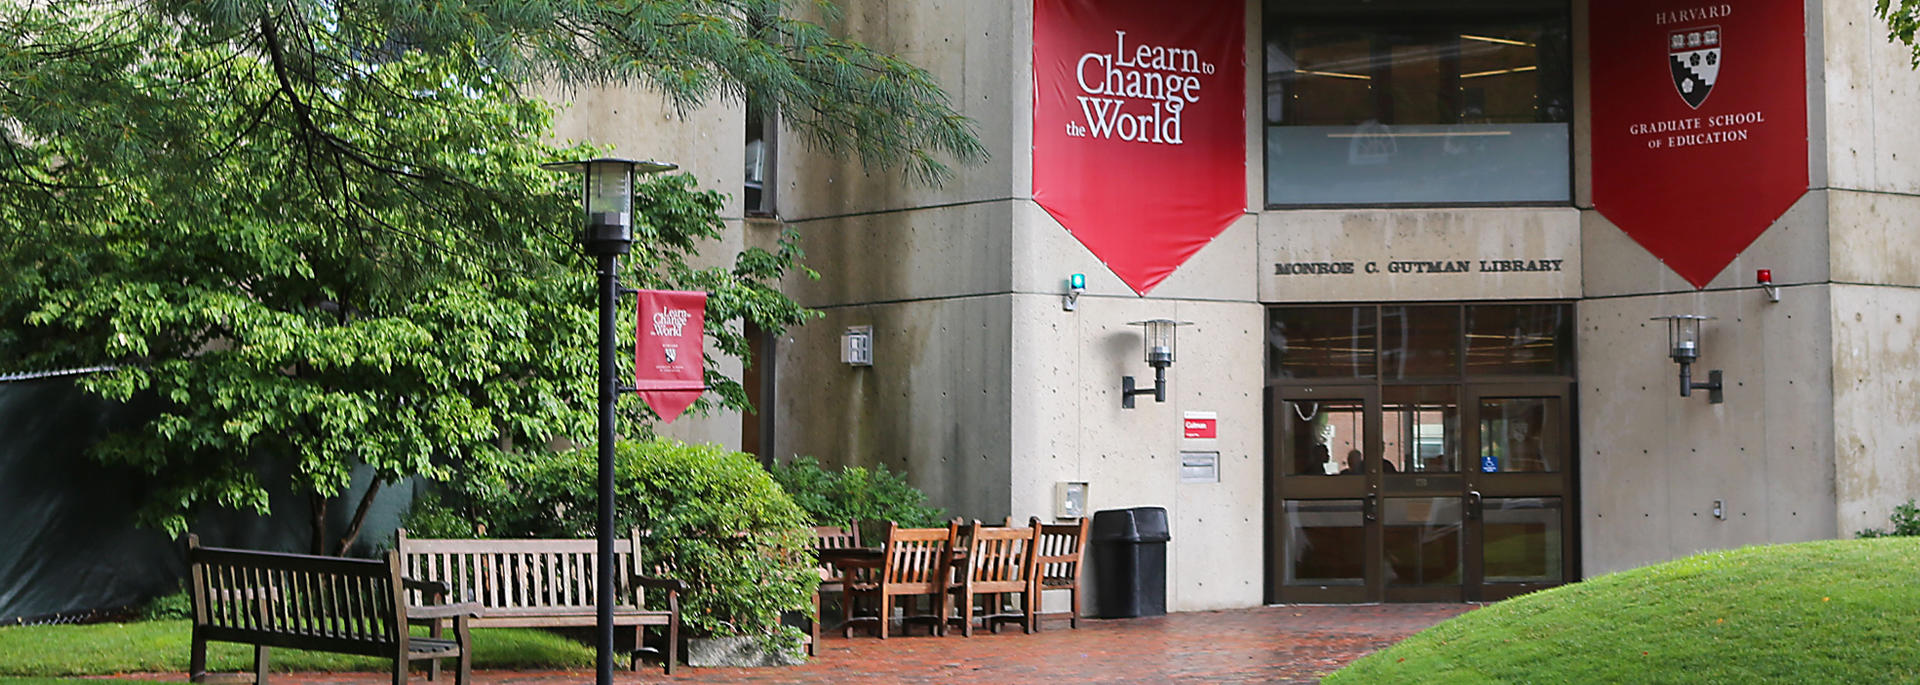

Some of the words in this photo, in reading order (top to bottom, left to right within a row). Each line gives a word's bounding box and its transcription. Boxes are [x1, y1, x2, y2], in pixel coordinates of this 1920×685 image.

[1656, 4, 1732, 25] HARVARD
[1115, 30, 1200, 73] Learn
[1202, 61, 1215, 75] to
[1076, 53, 1200, 114] Change
[1066, 121, 1087, 137] the
[1077, 95, 1183, 144] World
[1630, 117, 1701, 135] GRADUATE
[1708, 112, 1765, 127] SCHOOL
[1648, 139, 1662, 148] OF
[1668, 129, 1748, 147] EDUCATION
[1275, 262, 1354, 275] MONROE
[1365, 261, 1380, 274] C.
[1388, 260, 1470, 274] GUTMAN
[1479, 259, 1564, 273] LIBRARY
[653, 312, 688, 327] Change
[663, 305, 687, 318] Learn
[653, 323, 682, 336] World
